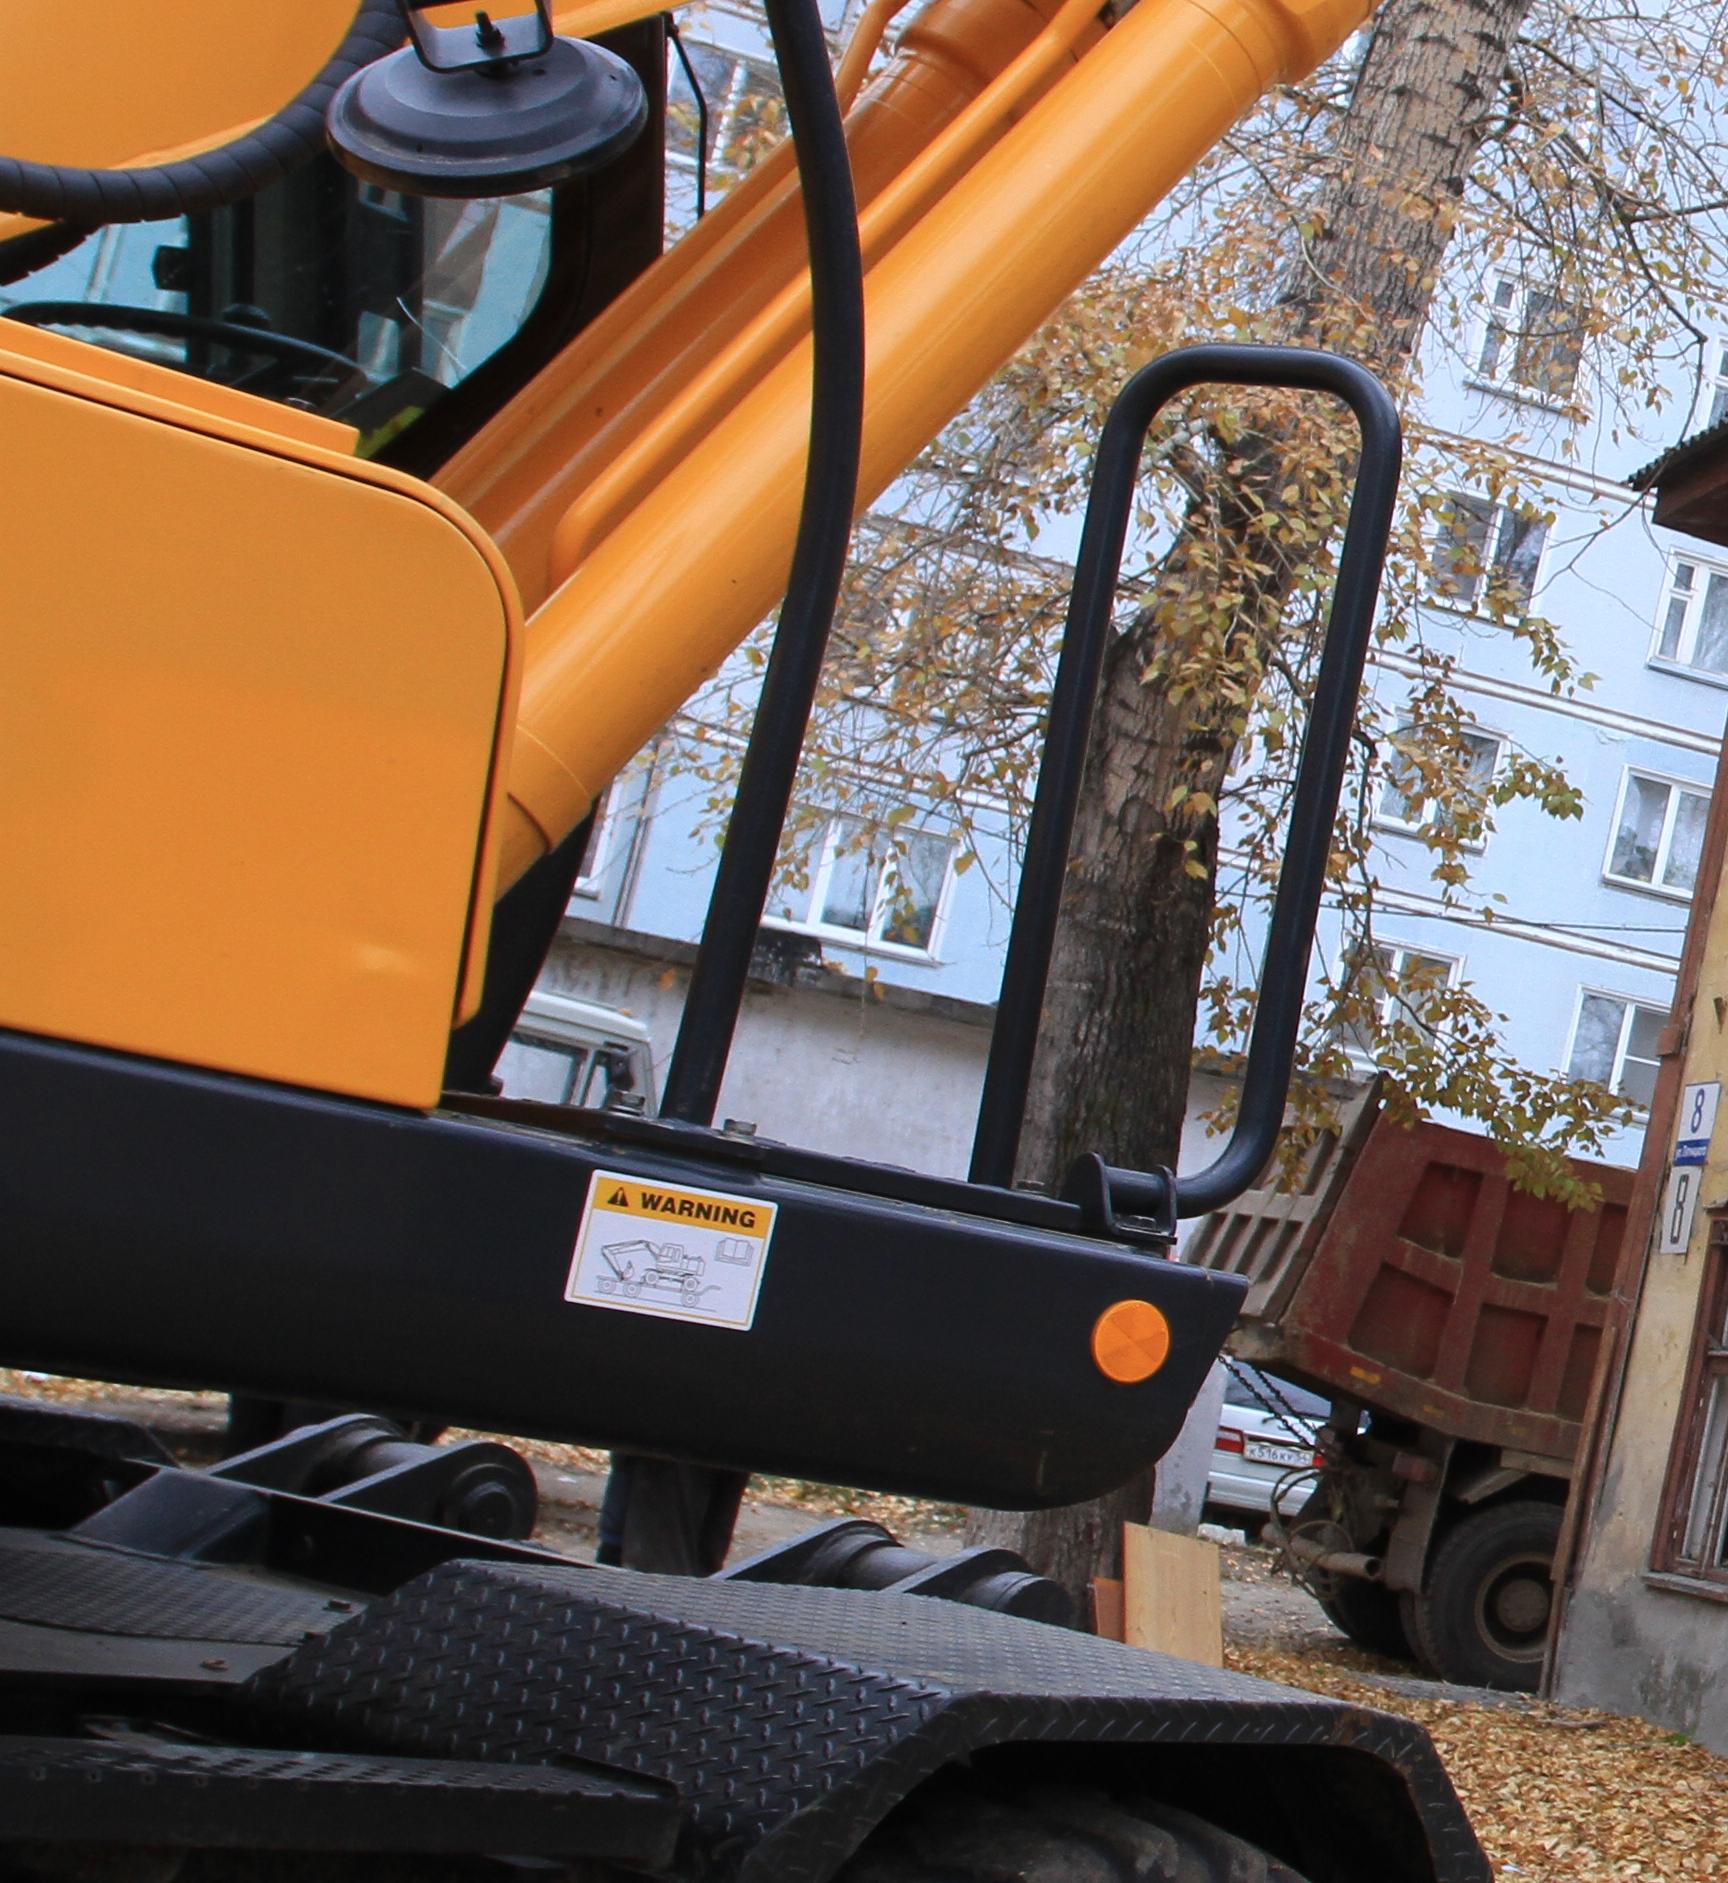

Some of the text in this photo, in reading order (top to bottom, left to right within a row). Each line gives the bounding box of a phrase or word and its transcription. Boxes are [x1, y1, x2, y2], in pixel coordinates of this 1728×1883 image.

[1690, 1088, 1705, 1134] 8
[641, 1192, 756, 1229] WARNING
[1670, 1174, 1690, 1244] 8
